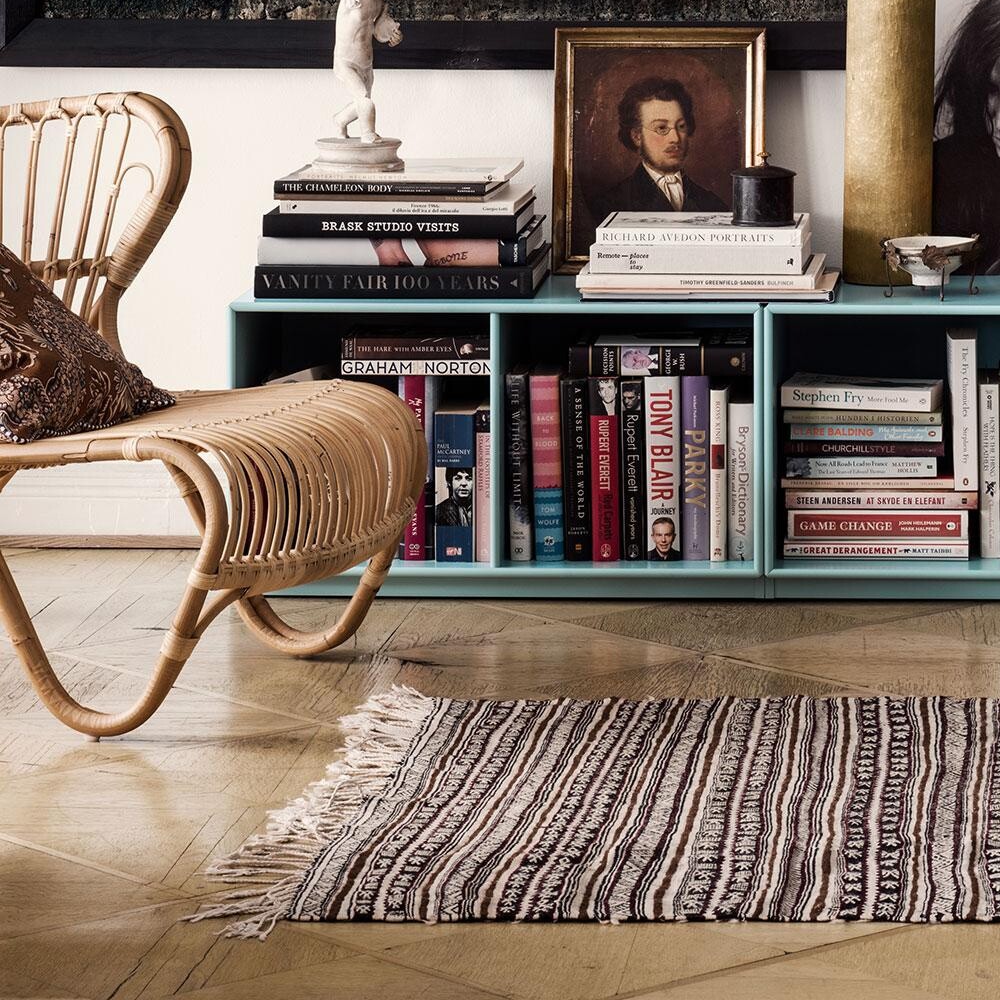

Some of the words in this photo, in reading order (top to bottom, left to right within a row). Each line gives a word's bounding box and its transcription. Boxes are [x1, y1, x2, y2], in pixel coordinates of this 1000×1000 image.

[282, 183, 303, 191] THE
[305, 183, 364, 192] CHAMELEON
[367, 184, 393, 193] BODY
[322, 221, 363, 232] BRASK
[367, 221, 413, 232] STUDIO
[417, 222, 460, 233] VISITS
[602, 233, 656, 241] RICHARD
[660, 233, 706, 241] AVEDON
[710, 234, 775, 242] PORTRAITS
[629, 252, 649, 260] places
[263, 274, 338, 289] VANITY
[343, 274, 388, 289] FAIR
[394, 274, 430, 289] 100
[438, 275, 500, 290] YEARS
[342, 361, 412, 374] GRAHAM
[792, 389, 840, 405] Stephen
[844, 391, 864, 406] Fry
[574, 398, 583, 431] SENSE
[650, 389, 673, 439] TONY
[512, 411, 521, 467] WITHOUT
[598, 419, 610, 452] RUPERT
[623, 414, 639, 450] Rupert
[792, 427, 824, 436] CLARE
[827, 428, 874, 437] BALDING
[576, 436, 583, 450] OF
[576, 455, 584, 476] THE
[599, 455, 611, 491] EVERETT
[627, 455, 639, 492] Everett
[650, 445, 674, 500] BLAIR
[684, 430, 706, 508] PARKY
[577, 481, 585, 519] WORLD
[736, 473, 749, 536] Dictionary
[822, 497, 861, 505] ANDERSEN
[877, 497, 901, 505] SKYDE
[915, 497, 945, 505] ELEFANT
[650, 507, 676, 515] JOURNEY
[800, 521, 836, 531] GAME
[839, 521, 893, 531] CHANGE
